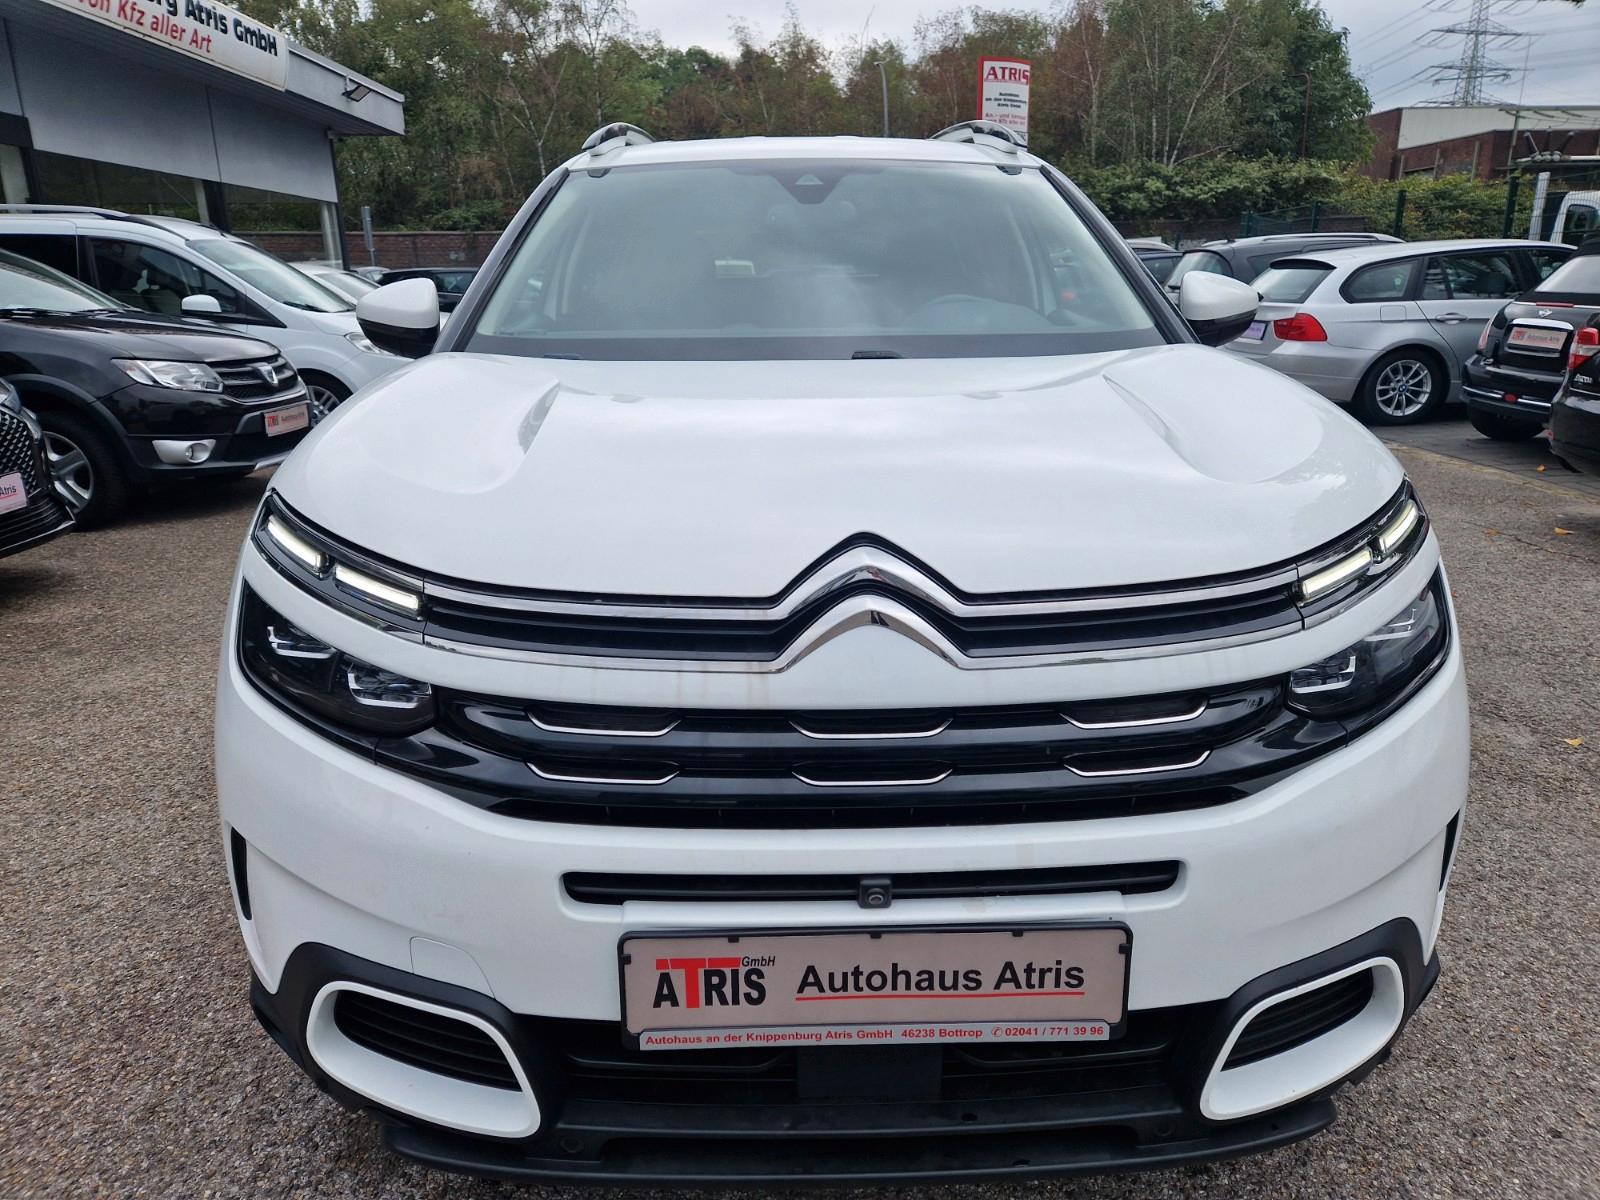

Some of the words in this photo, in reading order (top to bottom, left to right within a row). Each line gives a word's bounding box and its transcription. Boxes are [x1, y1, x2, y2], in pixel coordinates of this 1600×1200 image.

[116, 0, 145, 26] Kfz
[151, 15, 186, 42] aller
[189, 31, 212, 53] Art
[185, 0, 228, 34] Atris
[233, 18, 278, 56] GmbH
[986, 66, 1029, 85] ATRIS
[653, 957, 766, 1008] ATRIS
[741, 956, 776, 967] GmbH
[797, 963, 982, 993] Autohaus
[993, 960, 1085, 990] Atris
[646, 1034, 702, 1045] Autohaus
[706, 1034, 720, 1043] an
[723, 1033, 742, 1042] der
[746, 1031, 822, 1042] Knippenburg
[825, 1030, 853, 1040] Atris
[856, 1029, 893, 1039] GmbH
[901, 1028, 935, 1038] 46238
[939, 1028, 983, 1039] Bottrop
[1005, 1027, 1039, 1036] 02041
[1042, 1027, 1046, 1036] /
[1050, 1026, 1069, 1036] 771
[1073, 1026, 1087, 1036] 39
[1090, 1026, 1104, 1036] 96
